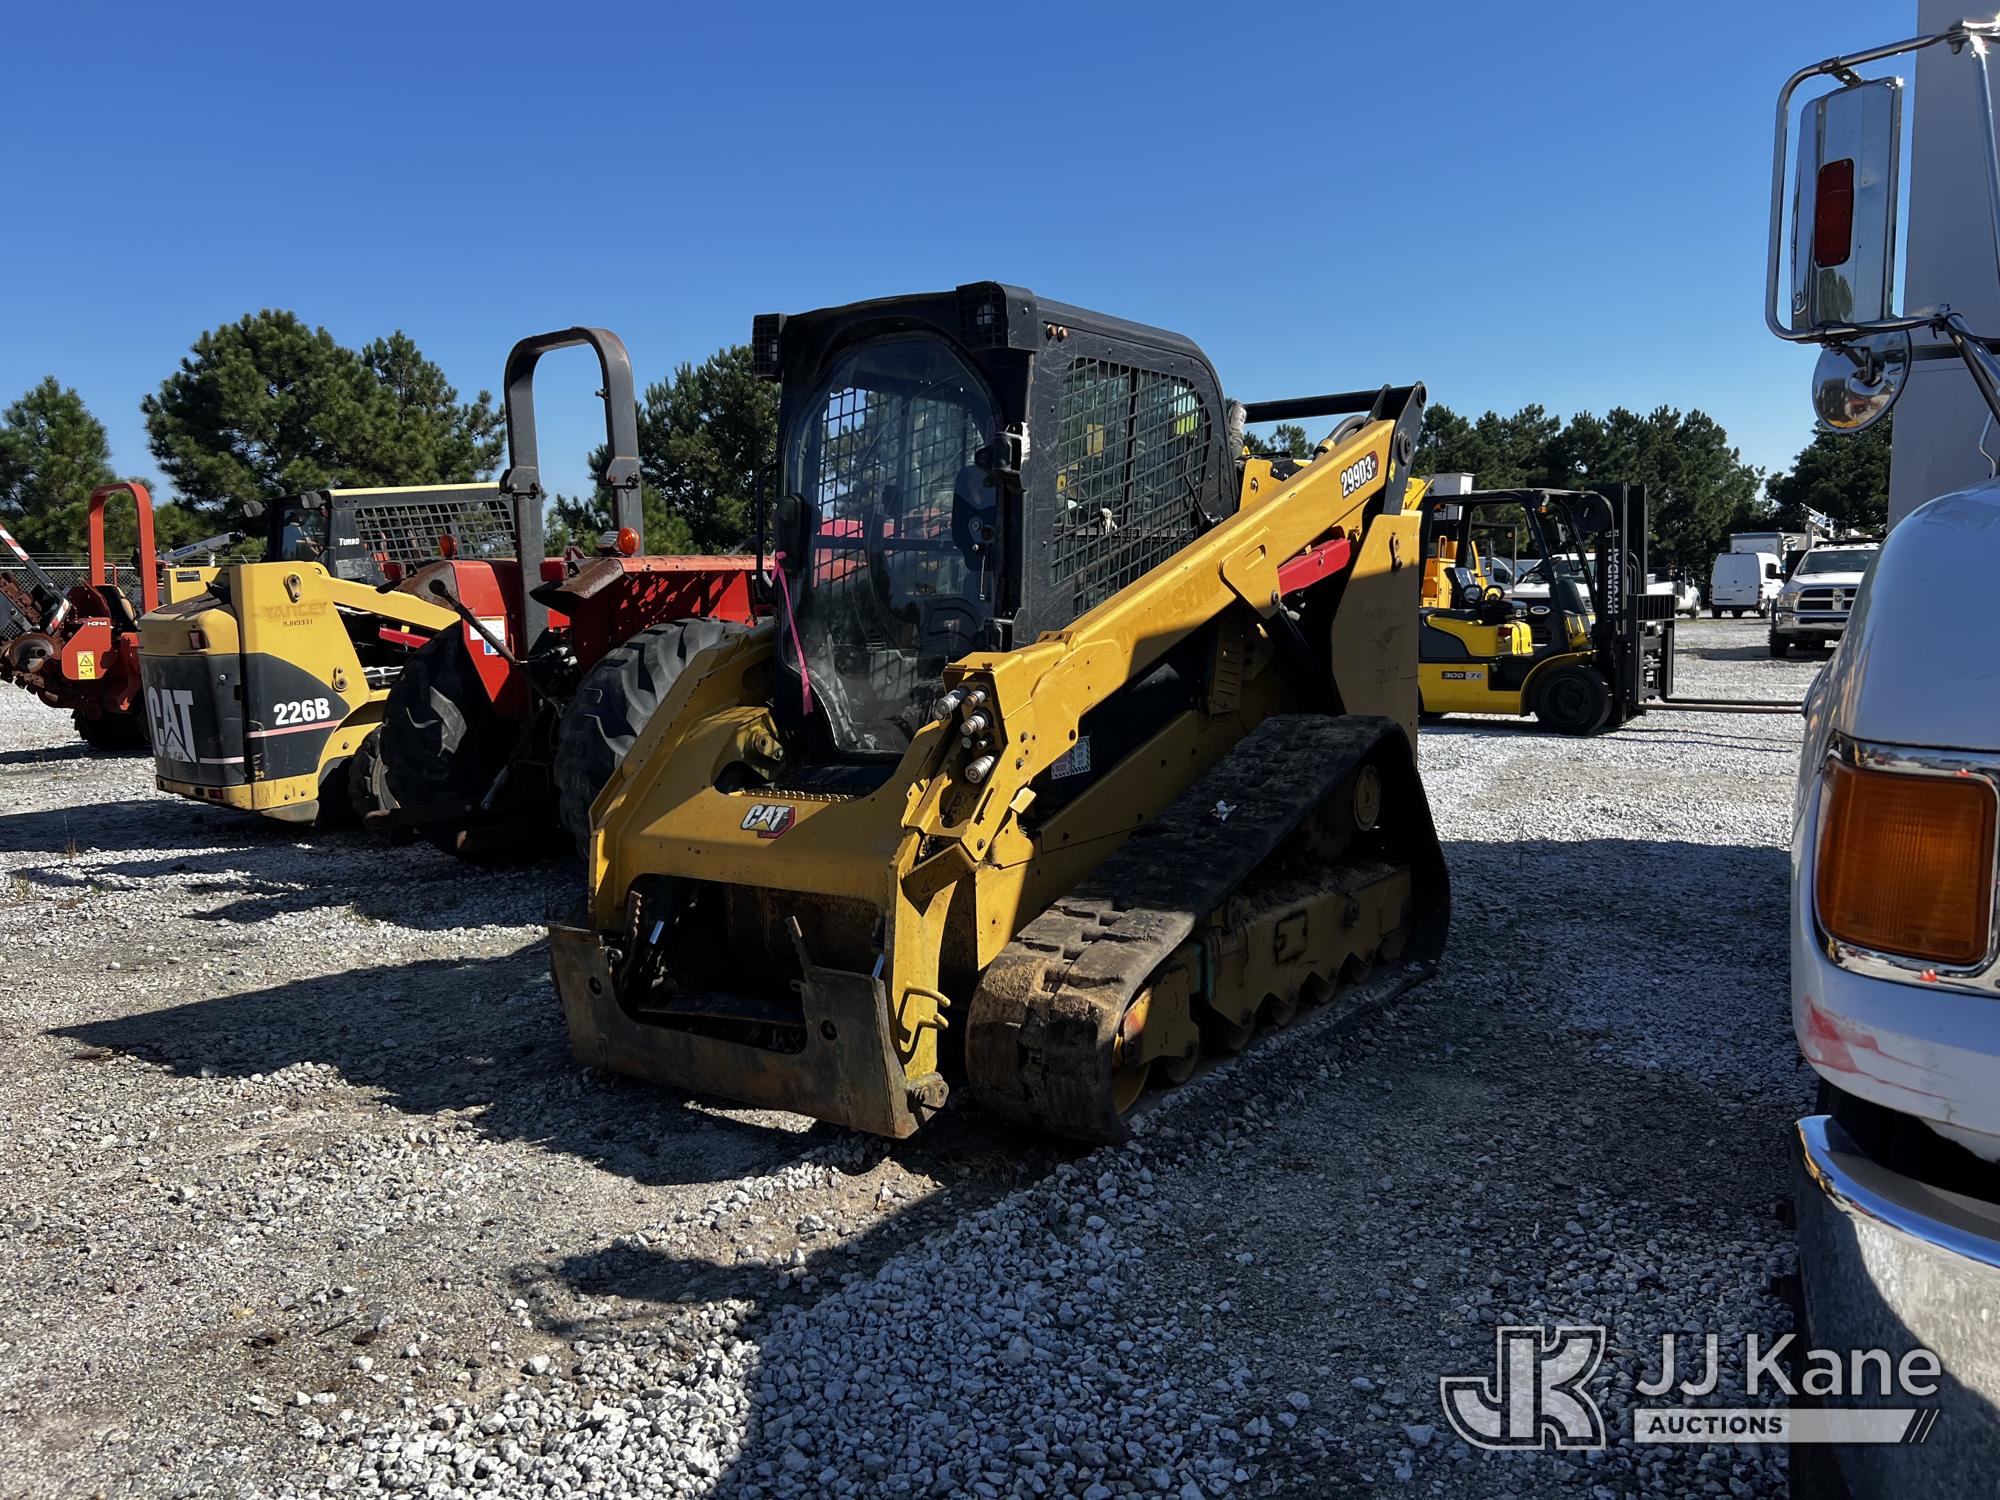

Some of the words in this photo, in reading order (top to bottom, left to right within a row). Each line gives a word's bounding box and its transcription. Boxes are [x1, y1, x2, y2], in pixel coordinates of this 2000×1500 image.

[1340, 454, 1373, 498] 299D3
[1606, 547, 1620, 615] HYUNDAI
[147, 686, 197, 763] CAT
[272, 697, 331, 726] 226B
[741, 804, 790, 832] CAT
